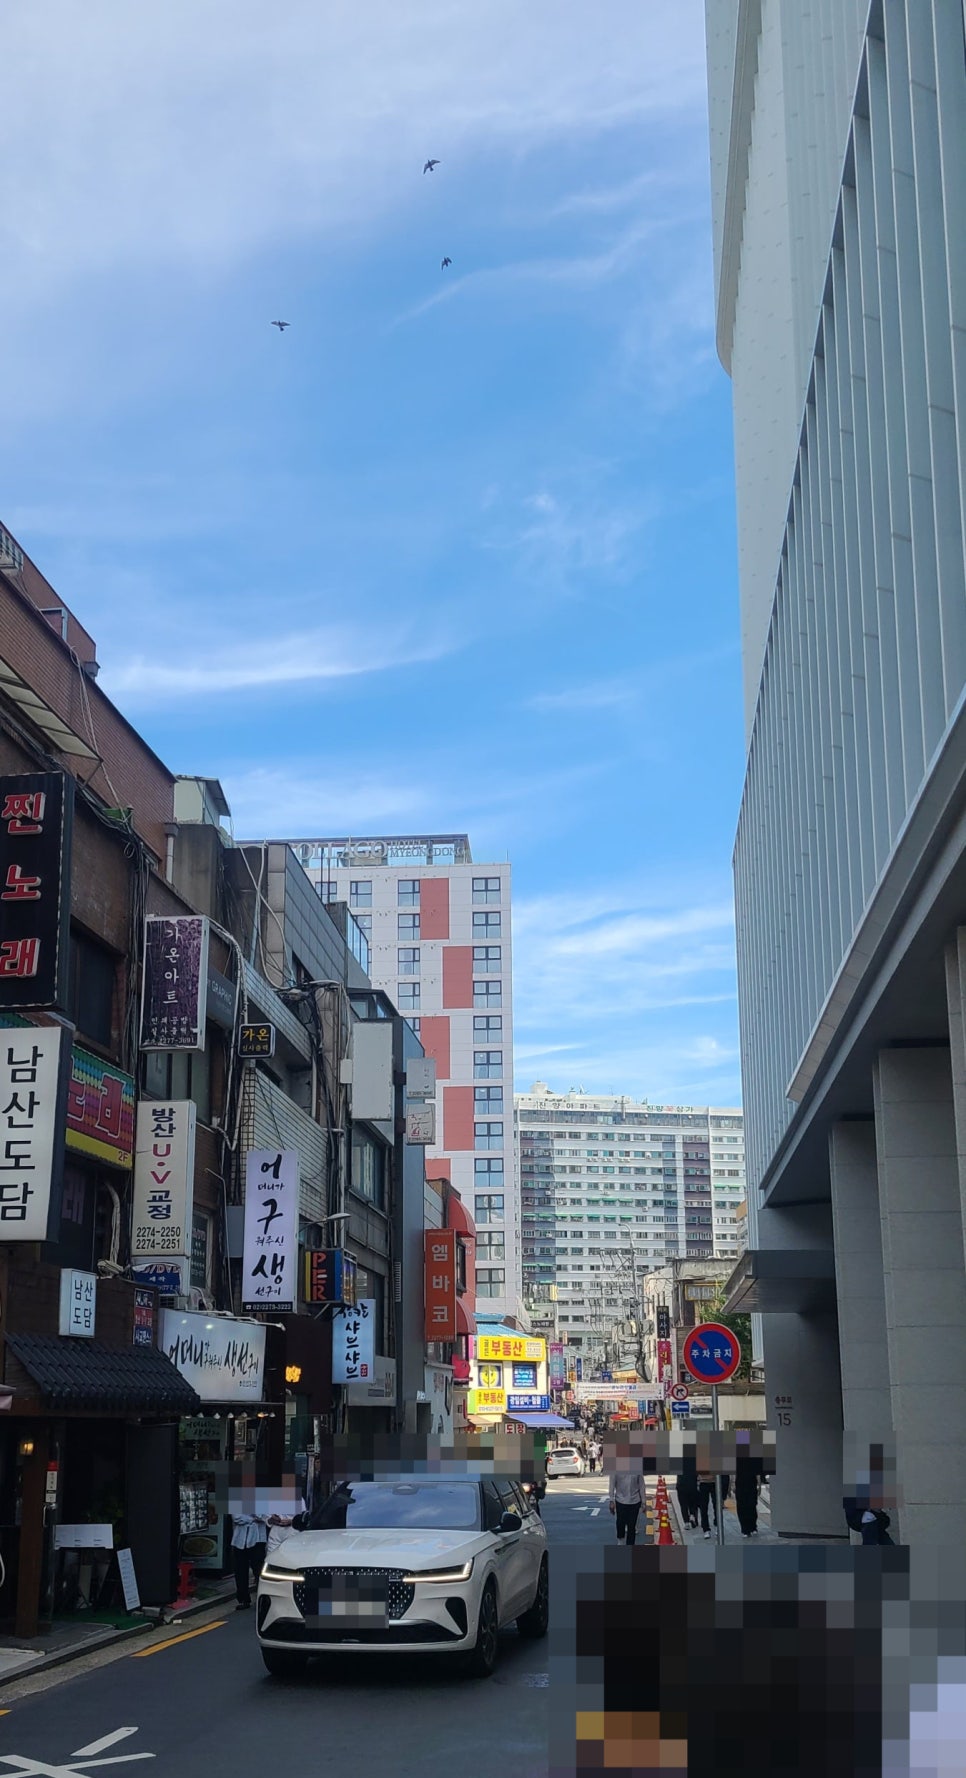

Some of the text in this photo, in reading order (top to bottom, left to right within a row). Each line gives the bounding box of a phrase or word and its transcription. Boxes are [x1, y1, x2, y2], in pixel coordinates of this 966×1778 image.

[1, 793, 45, 978] 찐노래
[163, 926, 182, 1004] 가온아트
[242, 1029, 270, 1042] 가온
[0, 1045, 44, 1221] 남산도담
[150, 1107, 177, 1138] 방산
[117, 1150, 129, 1162] 2F
[260, 1153, 283, 1179] 어
[146, 1189, 173, 1220] 교정
[256, 1198, 284, 1235] 구
[135, 1238, 180, 1250] 2274-2251
[136, 1226, 181, 1238] 2274-2250
[251, 1252, 285, 1285] 생
[74, 1279, 94, 1302] 남산
[431, 1244, 450, 1323] 엠바코
[72, 1307, 93, 1328] 도담
[659, 1313, 667, 1338] 마사지
[345, 1320, 360, 1379] 샤브샤브
[491, 1340, 523, 1356] 부동산
[691, 1347, 732, 1359] 주차금지
[483, 1392, 504, 1404] 부동산
[777, 1412, 793, 1426] 15
